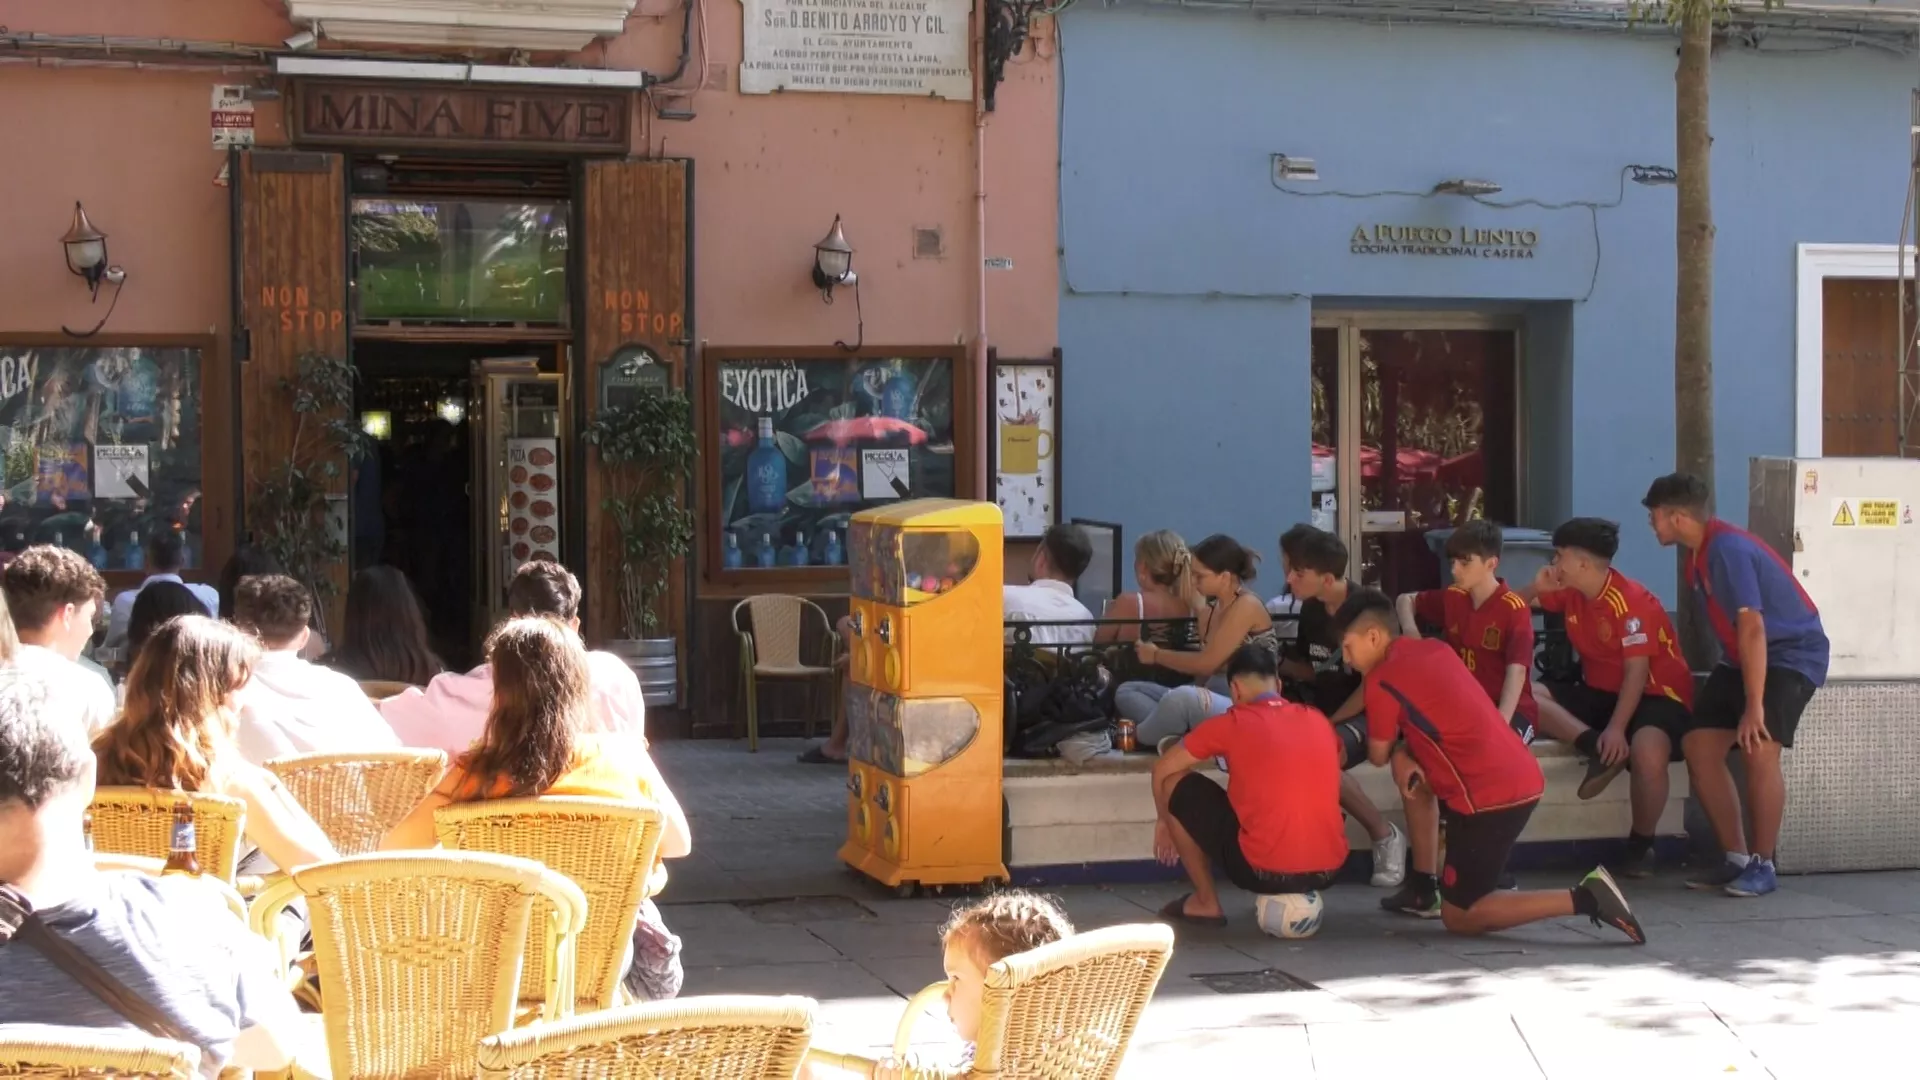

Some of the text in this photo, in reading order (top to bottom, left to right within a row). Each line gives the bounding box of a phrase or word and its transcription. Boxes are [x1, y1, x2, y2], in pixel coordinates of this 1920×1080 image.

[869, 1, 883, 9] DEL
[889, 2, 927, 11] ALCALDE
[802, 11, 848, 30] BENITO
[853, 13, 907, 33] ARROYO
[912, 15, 921, 34] Y
[843, 39, 913, 50] AYUNTAMIENTO
[810, 51, 859, 61] PERPETUAR
[862, 52, 879, 61] CON
[744, 61, 754, 70] LA
[791, 62, 830, 73] GRATITUD
[832, 64, 847, 74] QUE
[850, 65, 866, 74] POR
[868, 65, 899, 75] MEJORA
[901, 66, 915, 75] TAN
[792, 75, 825, 85] MERECE
[830, 76, 841, 85] SU
[214, 112, 252, 123] Alarma
[320, 94, 612, 138] MINA FIVE
[1350, 224, 1371, 243] A
[1350, 245, 1534, 260] COCINA TRADICIONAL CASERA
[262, 286, 309, 308] NON
[605, 289, 650, 311] NON
[281, 310, 343, 334] STOP
[621, 312, 682, 335] STOP
[722, 367, 810, 412] EXÓTICA
